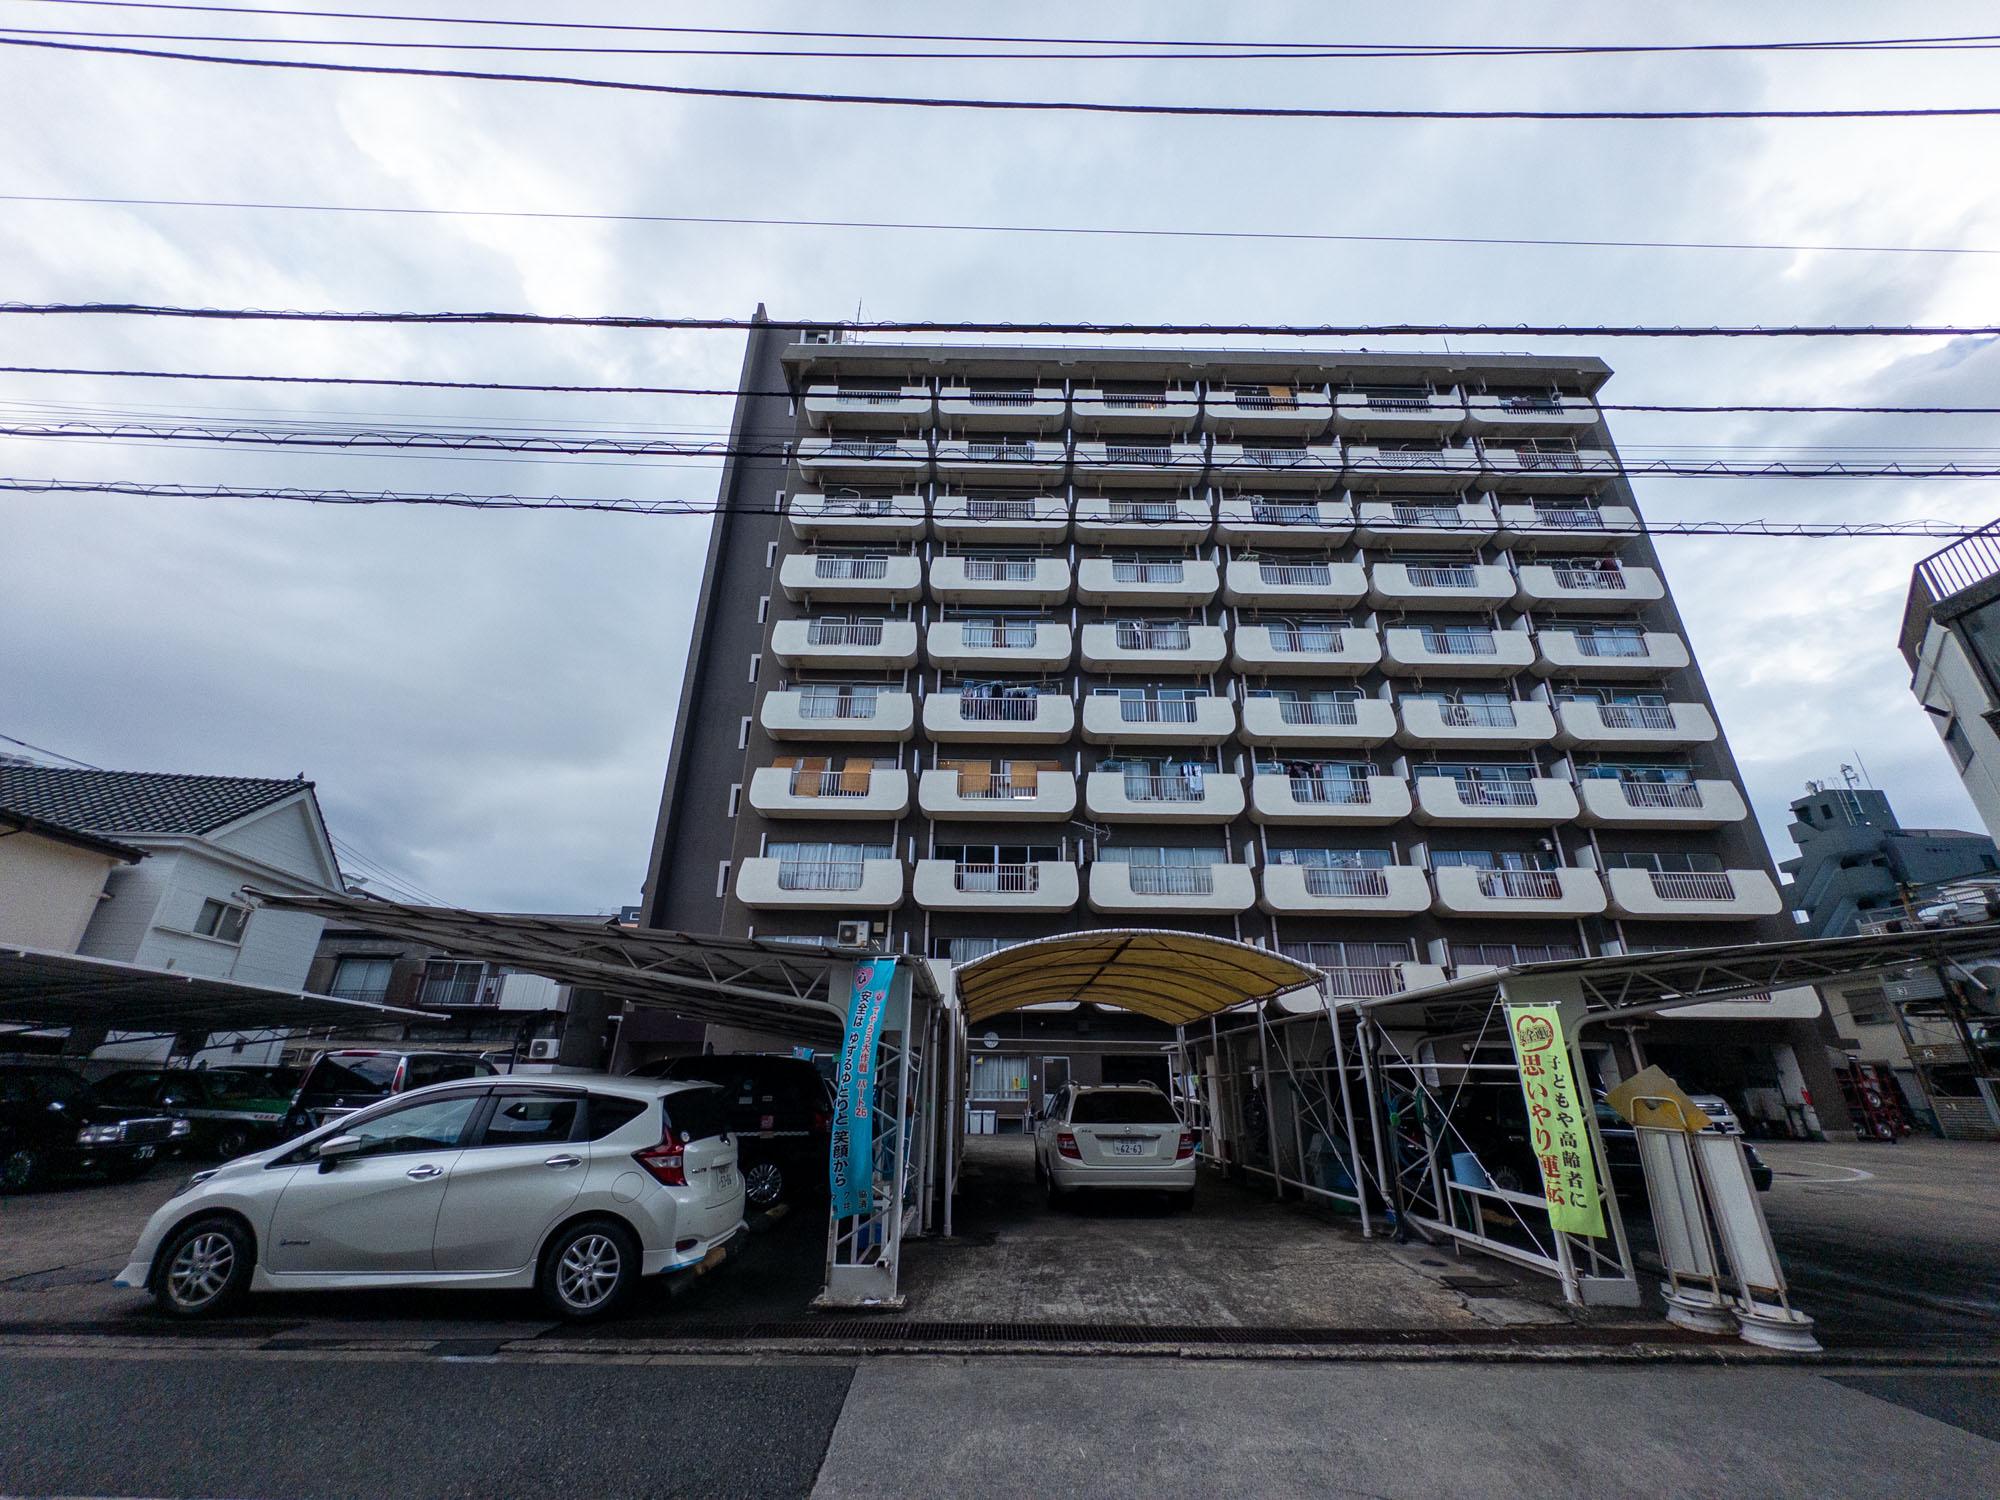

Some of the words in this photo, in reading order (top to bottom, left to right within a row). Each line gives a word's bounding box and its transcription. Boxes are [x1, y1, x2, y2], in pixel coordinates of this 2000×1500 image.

[1120, 1144, 1143, 1155] 62-63
[1522, 1053, 1566, 1206] 思いやり運転
[1547, 1054, 1588, 1209] 子どもや高齢者に
